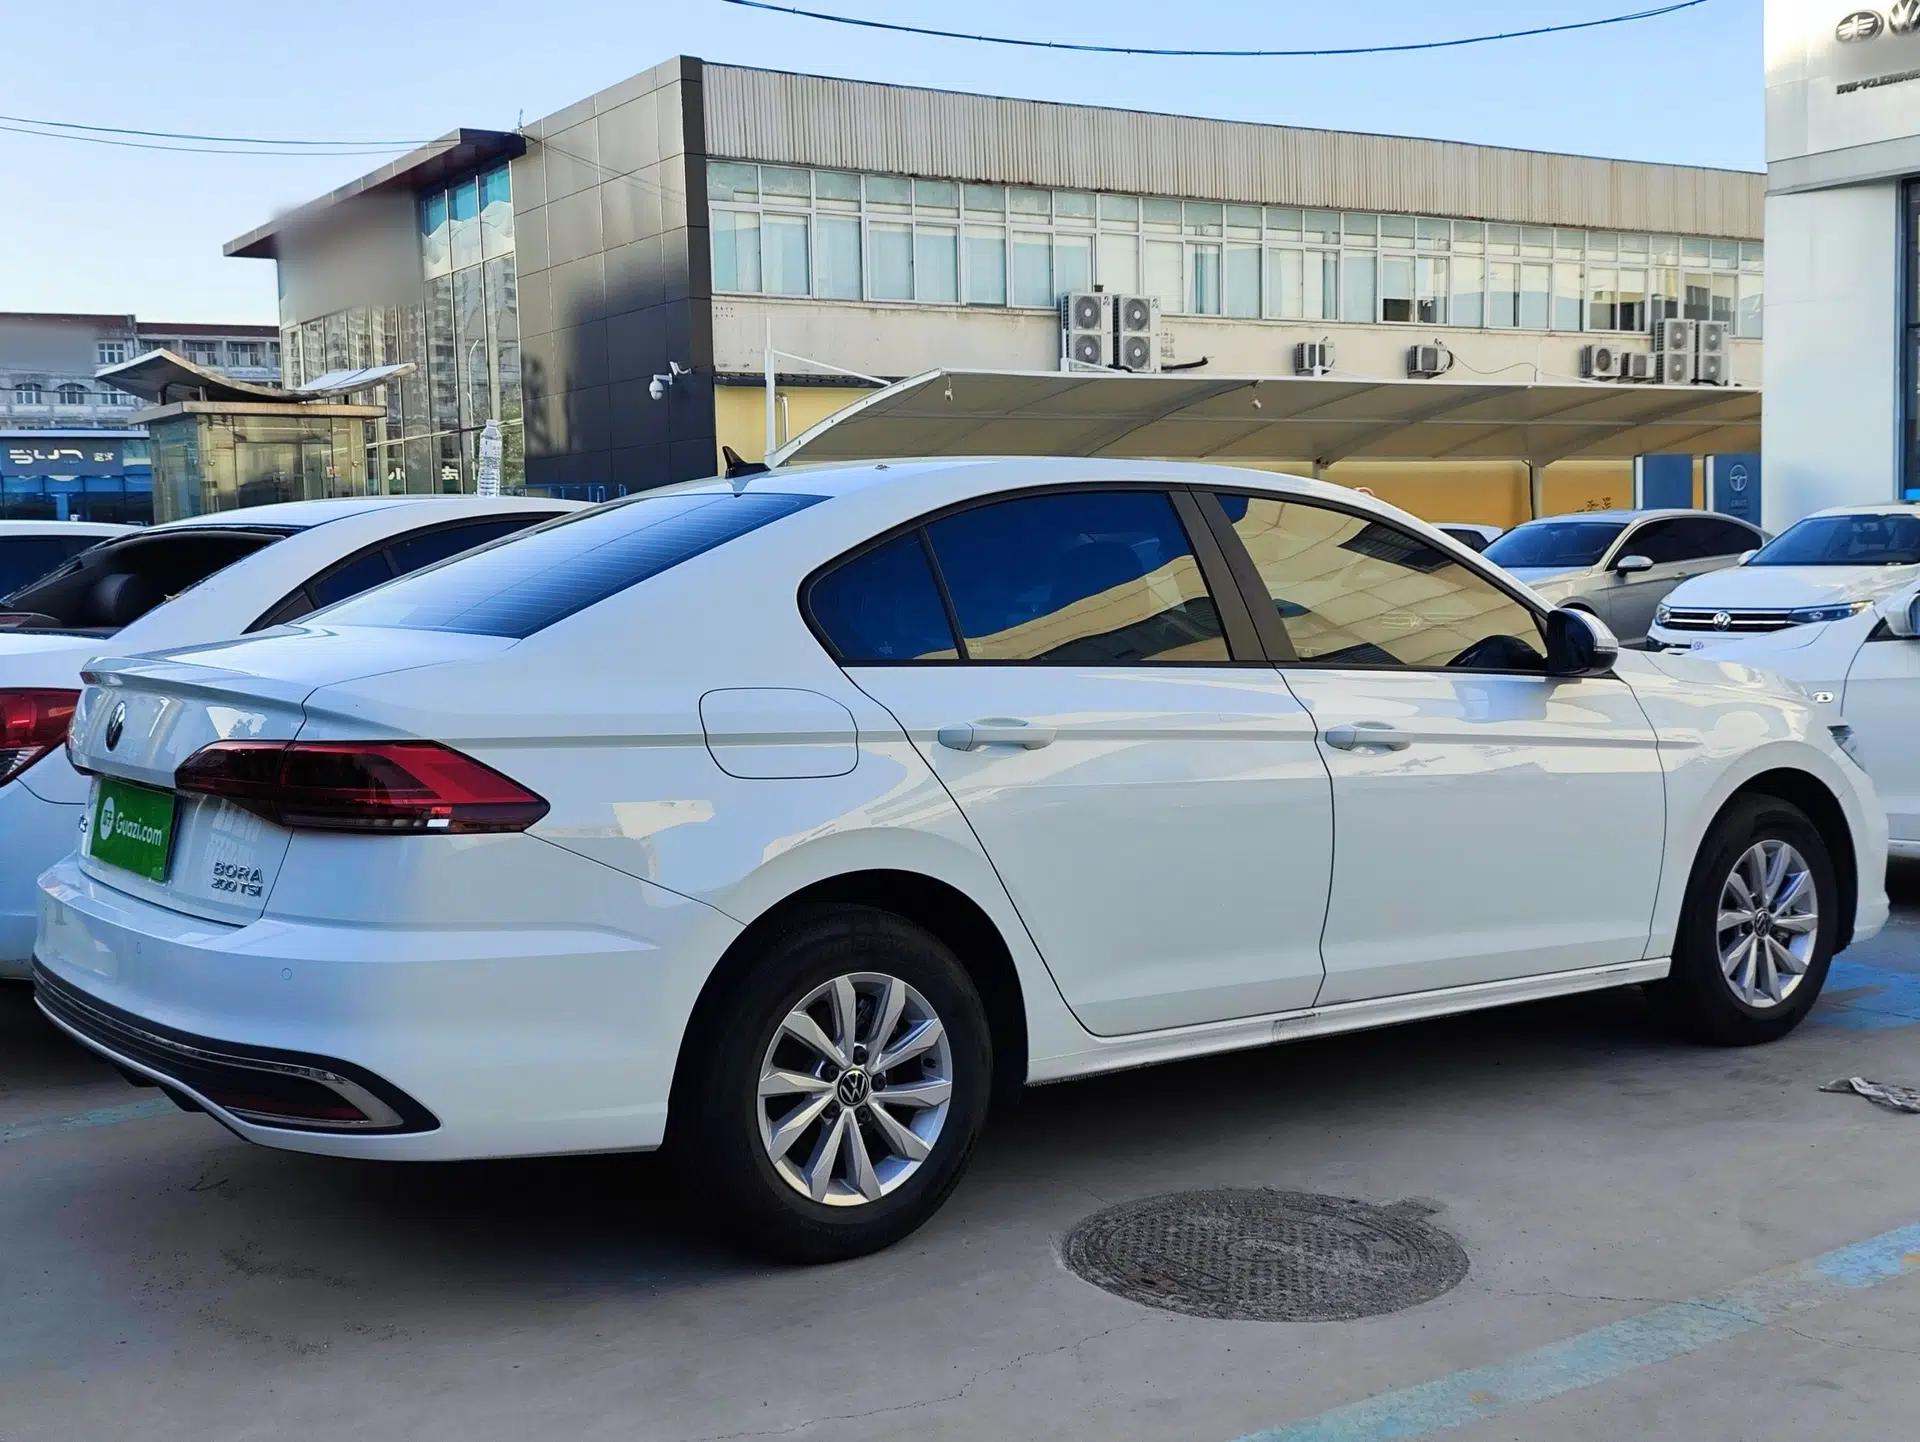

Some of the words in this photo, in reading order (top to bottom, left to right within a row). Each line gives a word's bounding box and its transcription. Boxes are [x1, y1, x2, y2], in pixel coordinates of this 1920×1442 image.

[115, 811, 162, 846] Guazi.com
[213, 861, 263, 883] BORA
[211, 877, 237, 892] 200
[240, 881, 263, 898] TSI
